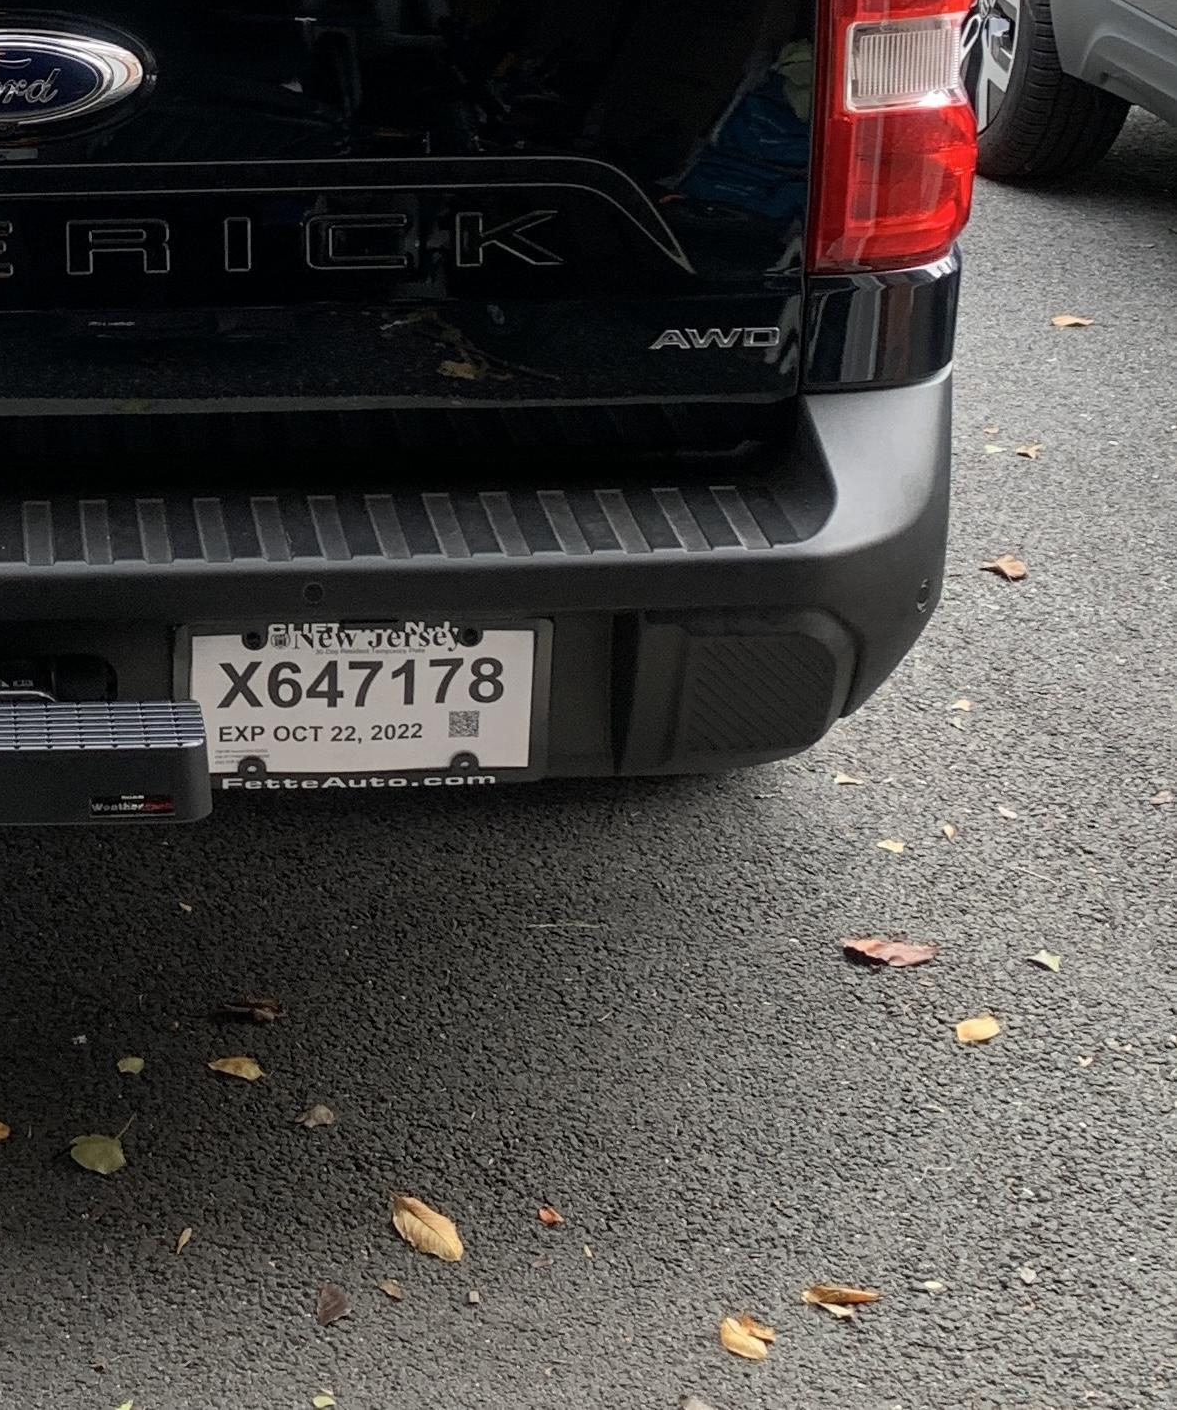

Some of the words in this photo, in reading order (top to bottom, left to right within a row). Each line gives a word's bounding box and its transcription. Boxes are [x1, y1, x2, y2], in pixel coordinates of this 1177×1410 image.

[648, 326, 781, 350] AWD
[293, 631, 358, 648] New
[367, 625, 460, 652] Jersey
[216, 657, 505, 709] X647178
[219, 725, 265, 742] EXP
[273, 725, 323, 742] OCT
[331, 725, 362, 744] 22,
[371, 722, 423, 741] 2022
[222, 774, 496, 790] FetteAuto.com
